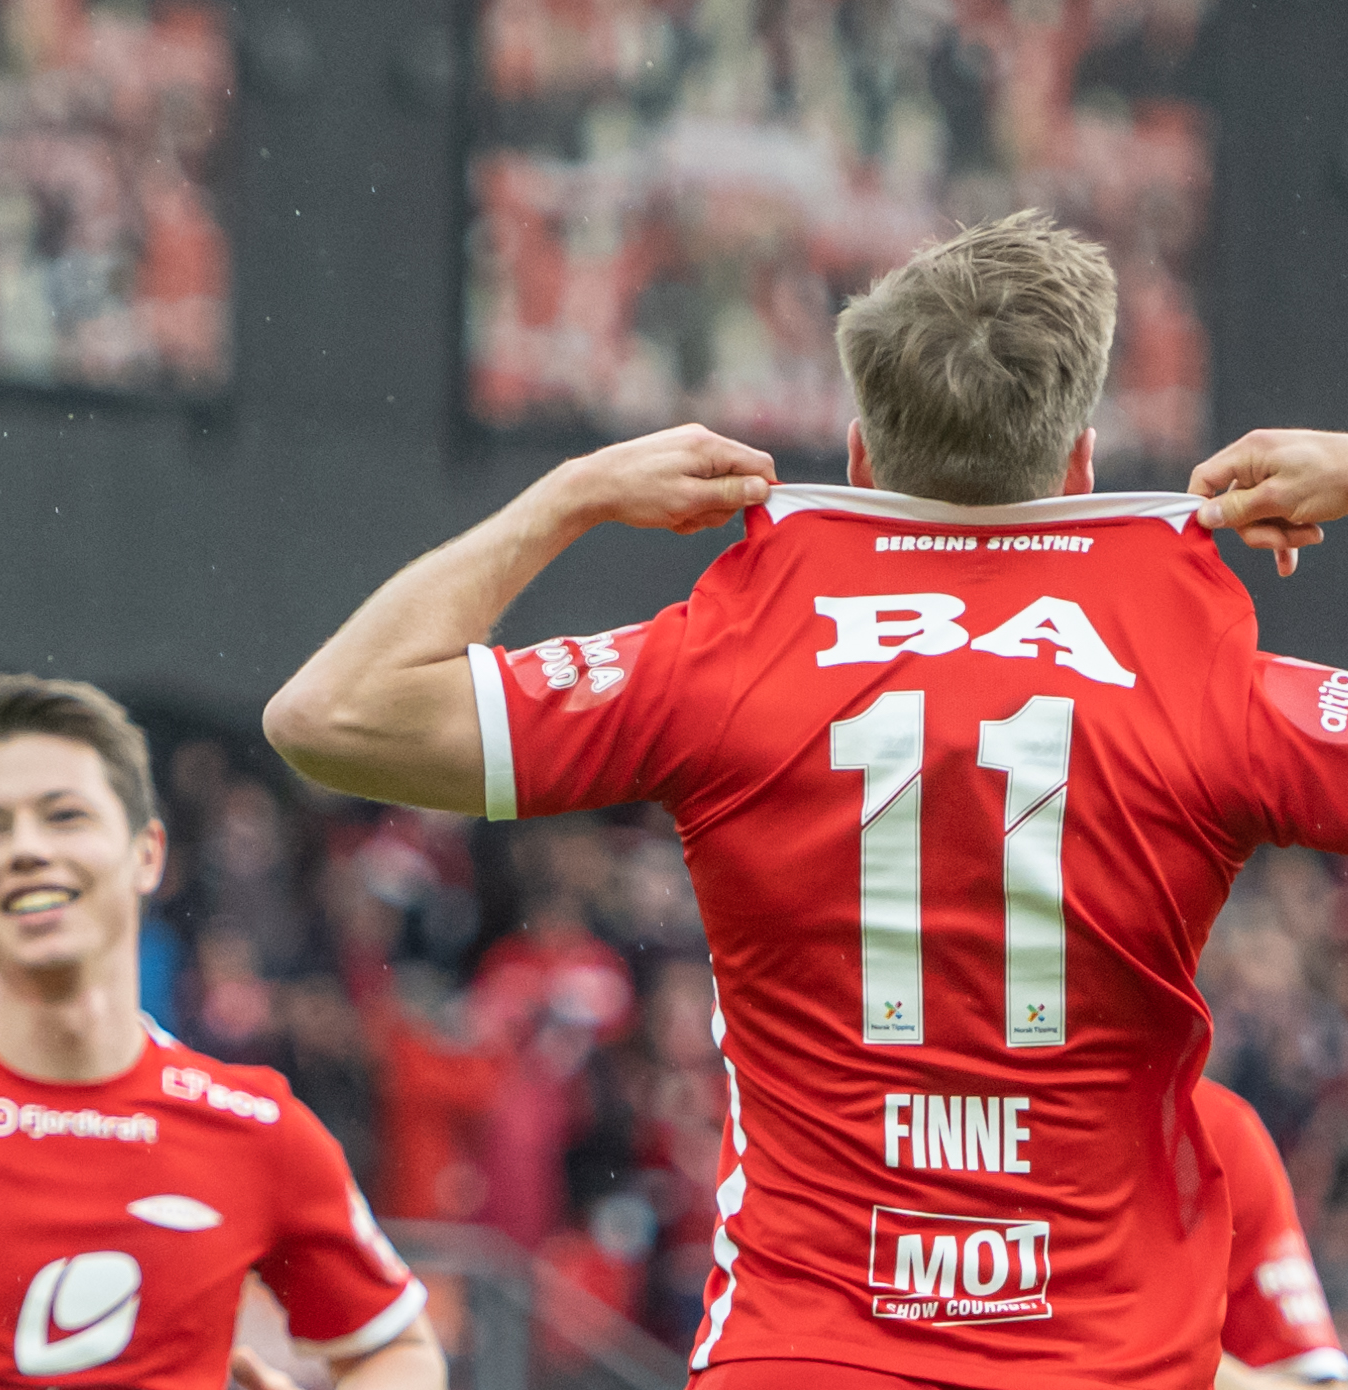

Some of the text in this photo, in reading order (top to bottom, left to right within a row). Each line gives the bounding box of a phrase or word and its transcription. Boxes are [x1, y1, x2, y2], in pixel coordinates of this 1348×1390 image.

[875, 535, 1095, 553] BERGENS STOLTHET
[814, 593, 1136, 688] BA
[830, 690, 1074, 1048] 11
[884, 1094, 1031, 1174] FINNE
[893, 1222, 1050, 1298] MOT
[885, 1301, 940, 1320] SHOW
